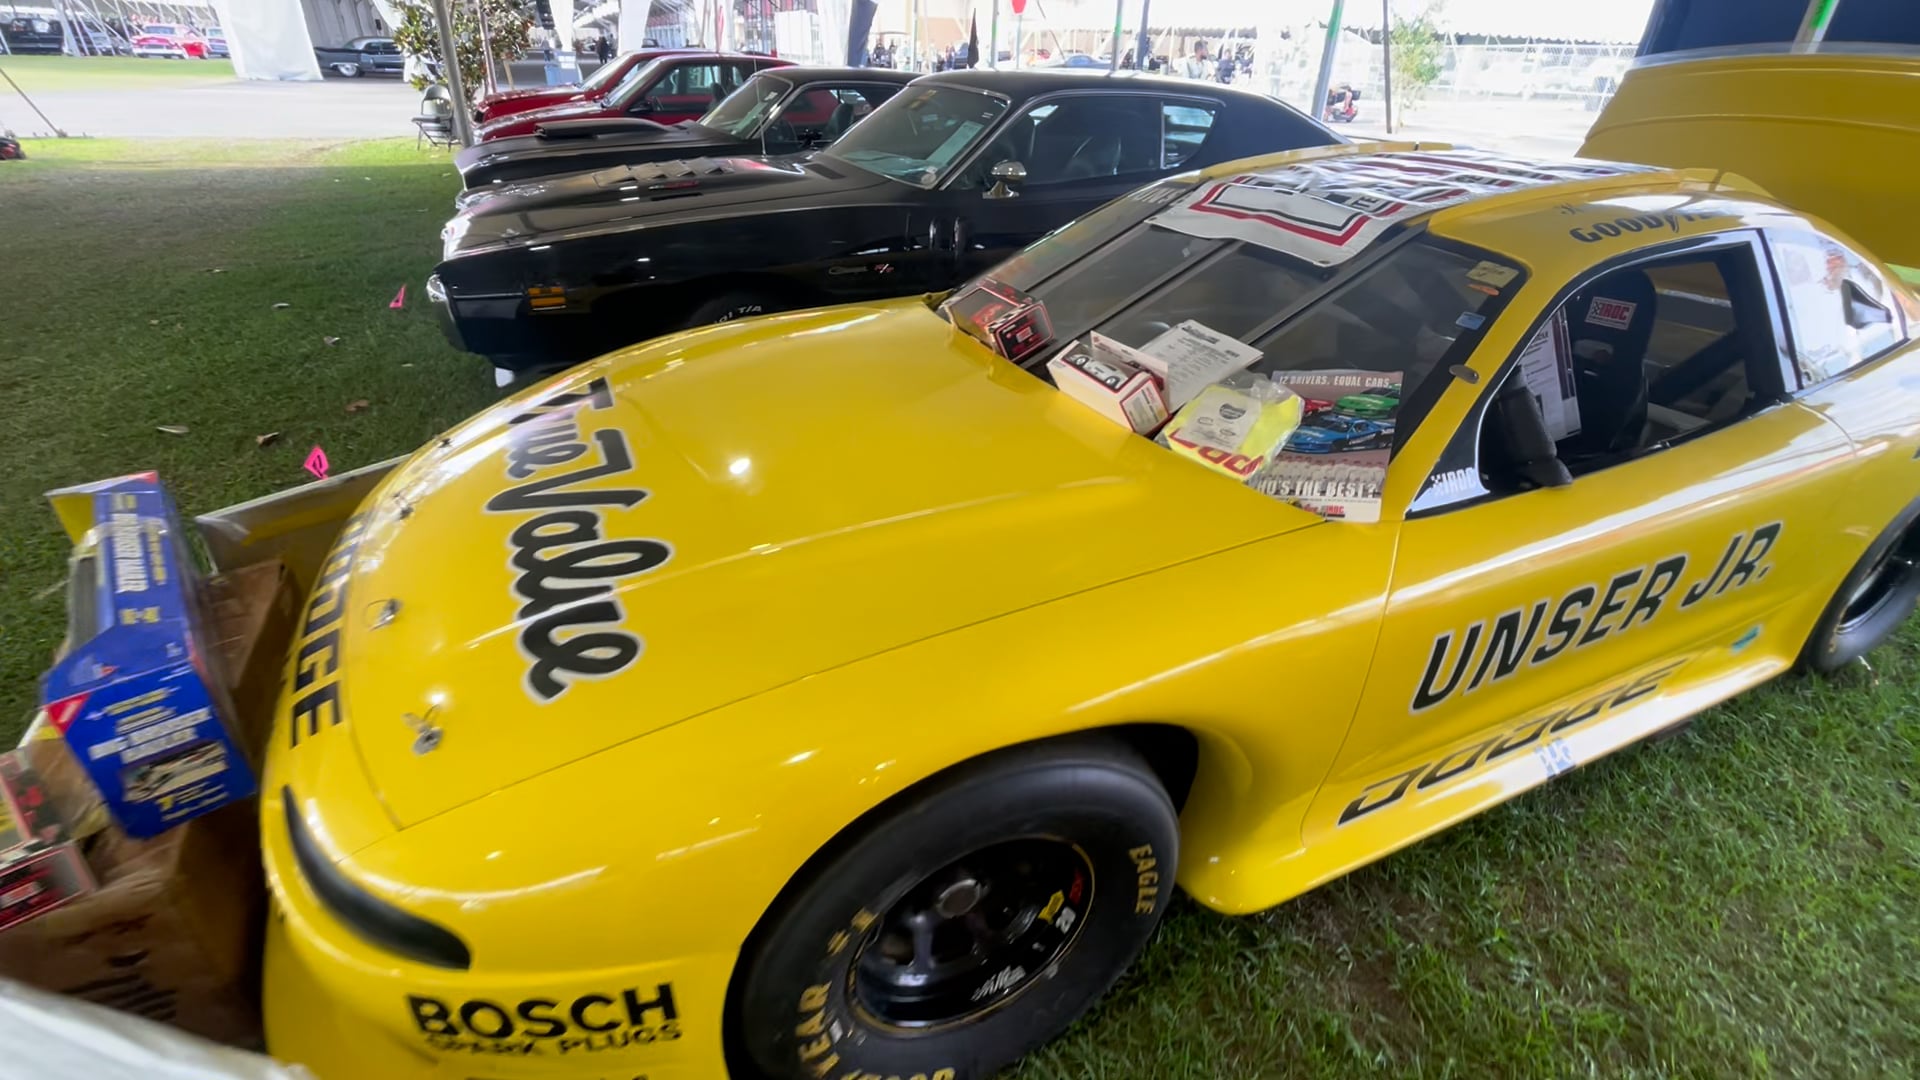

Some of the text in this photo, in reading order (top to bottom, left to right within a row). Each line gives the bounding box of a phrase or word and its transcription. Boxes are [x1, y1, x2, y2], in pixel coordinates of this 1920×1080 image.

[1290, 375, 1330, 386] DRIVERS.
[1334, 375, 1361, 388] EQUAL
[1365, 376, 1393, 389] CARS.
[509, 376, 614, 479] True
[1256, 480, 1378, 499] HO'S THE BEST?
[486, 428, 672, 701] Value
[1412, 522, 1782, 710] UNSER JR.
[1337, 658, 1688, 826] DODGE
[1129, 844, 1159, 915] EAGLE
[406, 982, 678, 1039] BOSCH
[558, 1023, 683, 1055] PLUGS
